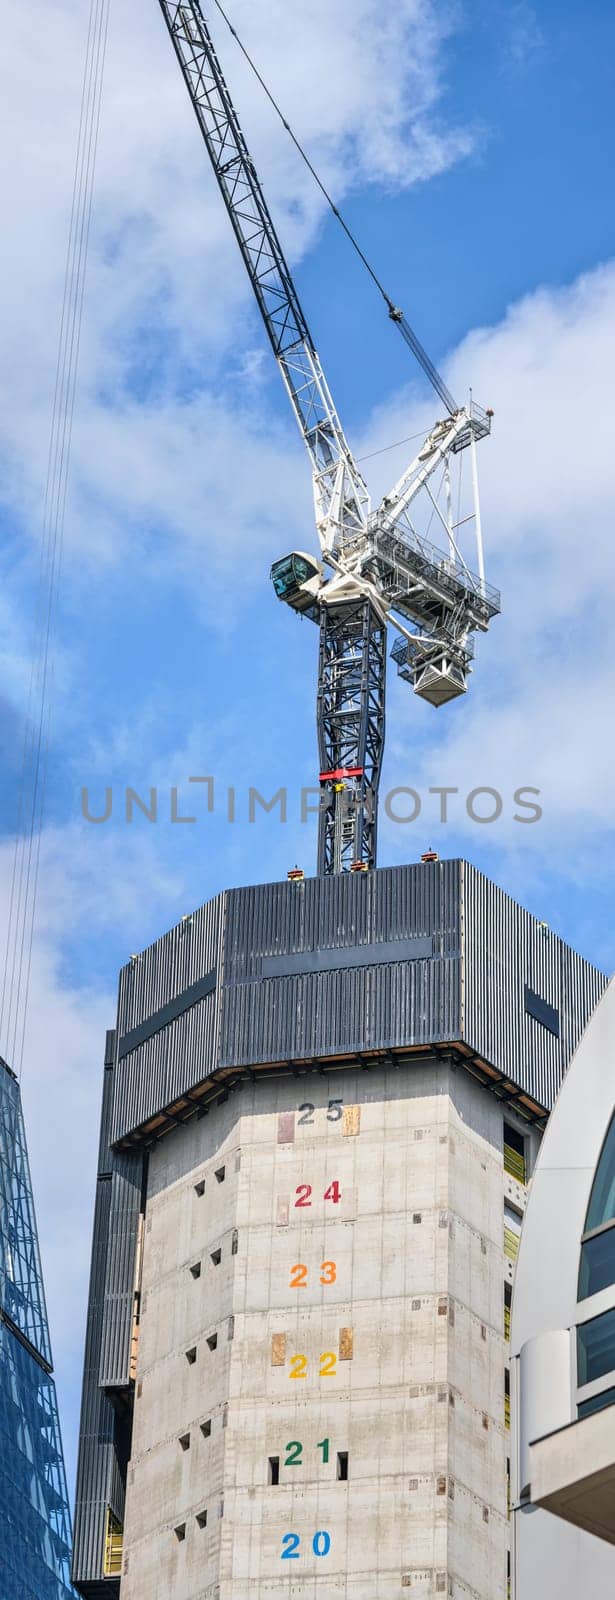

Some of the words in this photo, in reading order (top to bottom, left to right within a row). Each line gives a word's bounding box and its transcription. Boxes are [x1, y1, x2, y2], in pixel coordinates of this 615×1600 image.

[297, 1099, 343, 1126] 25
[294, 1181, 342, 1207] 24
[289, 1261, 337, 1288] 23
[288, 1352, 337, 1379] 22
[284, 1438, 329, 1466] 21
[280, 1531, 331, 1559] 20
